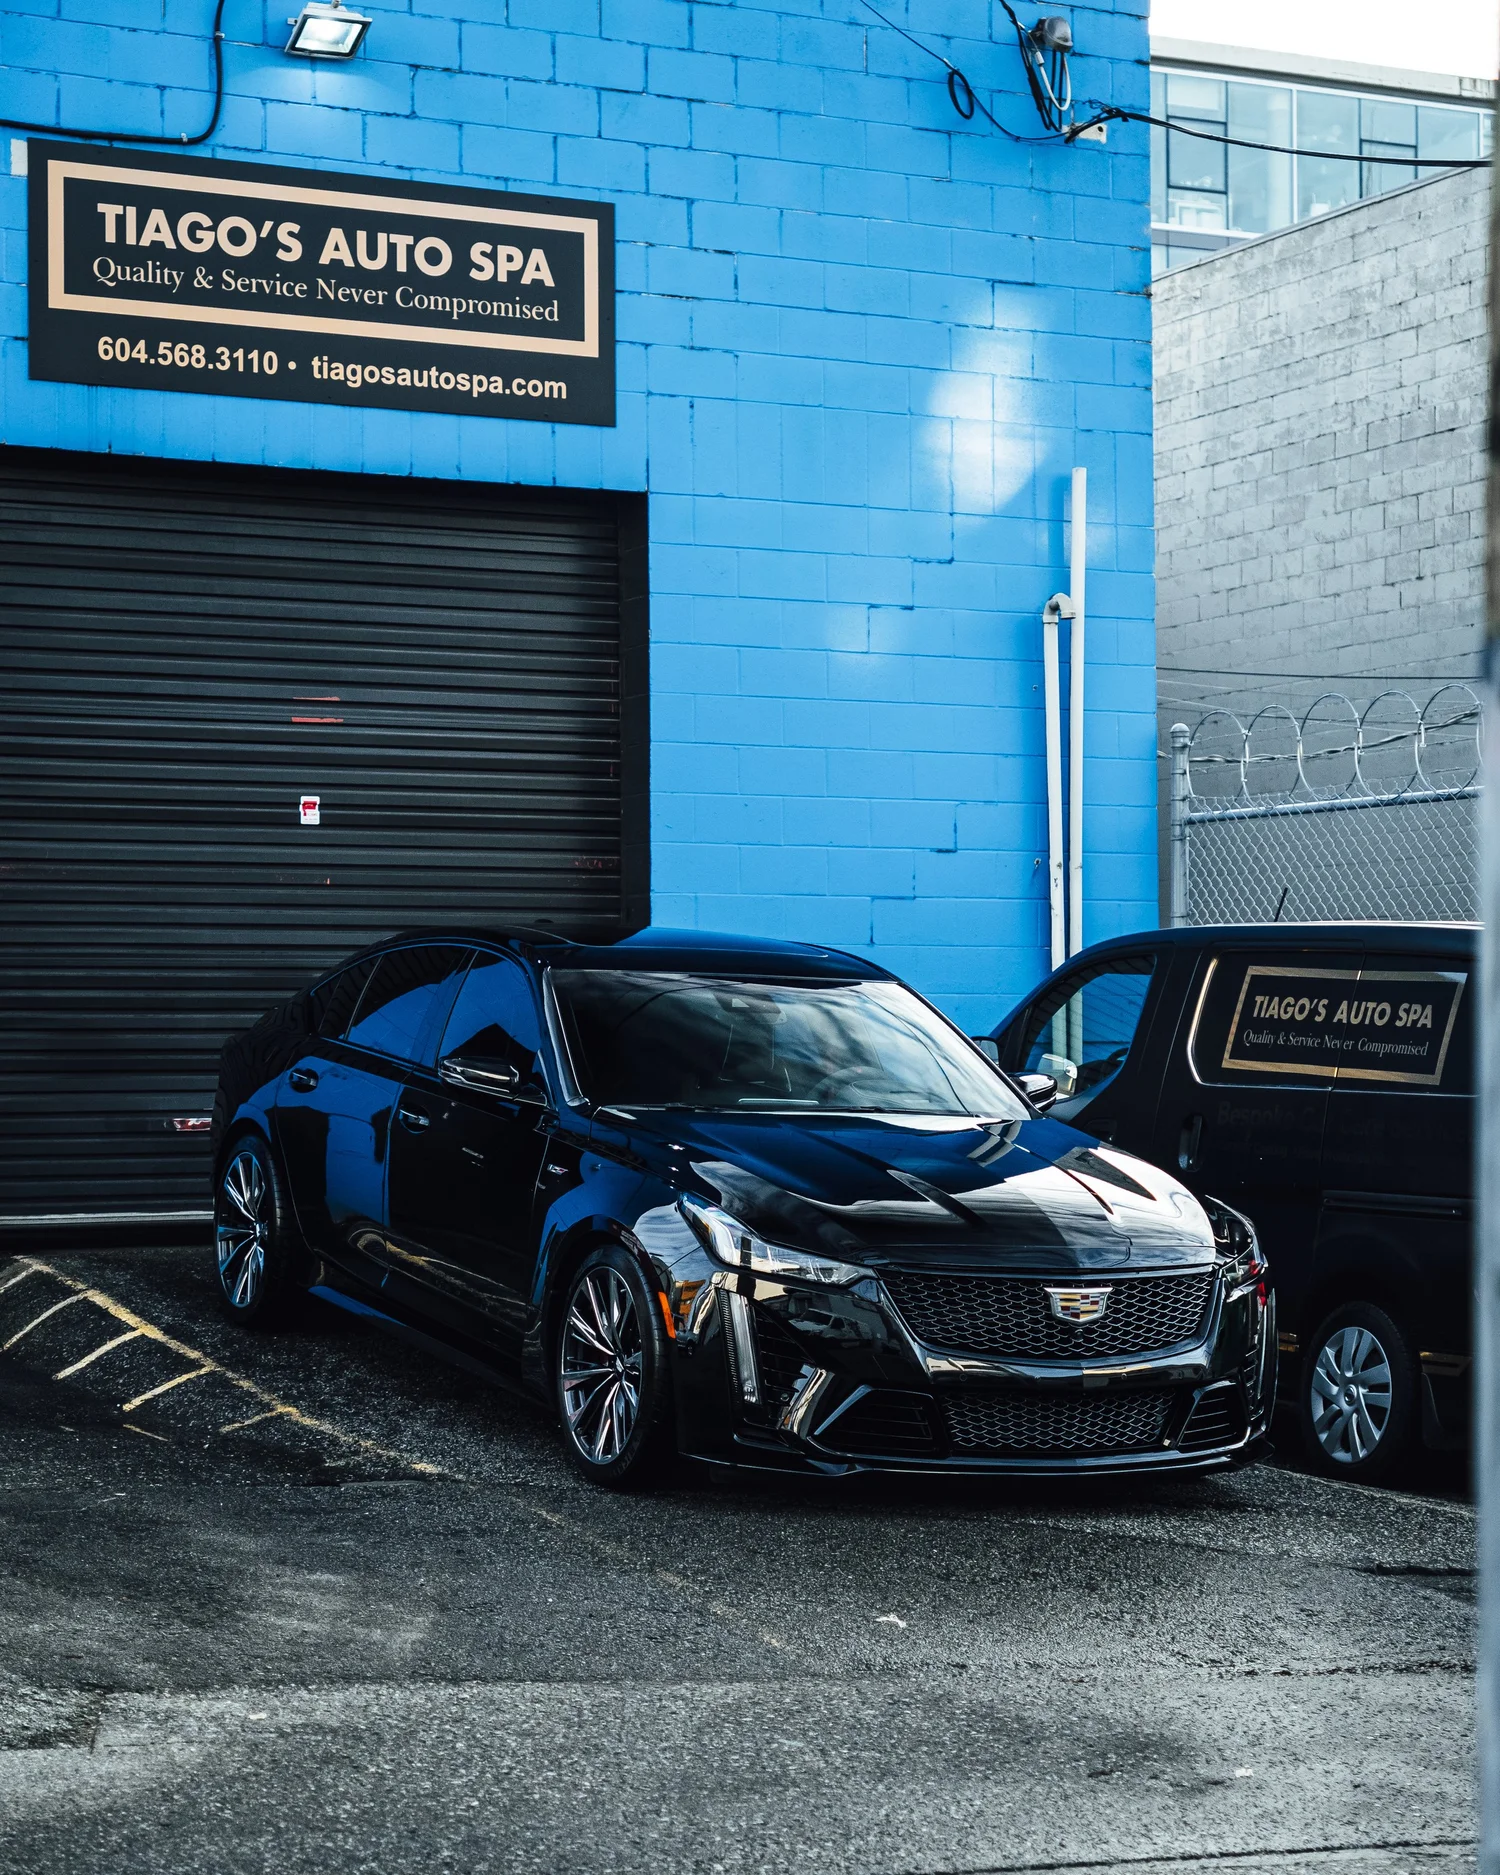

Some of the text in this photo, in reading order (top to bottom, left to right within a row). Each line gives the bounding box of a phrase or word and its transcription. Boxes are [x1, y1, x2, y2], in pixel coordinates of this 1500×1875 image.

[97, 203, 555, 287] TIAGO'S AUTO SPA
[93, 256, 560, 322] Quality & Service Never Compromised
[97, 336, 568, 399] 604.568.3110 tiagosautospa.com
[1243, 1029, 1429, 1057] Quality & Service Never Compromised
[1253, 995, 1433, 1028] TIAGO'S AUTO SPA
